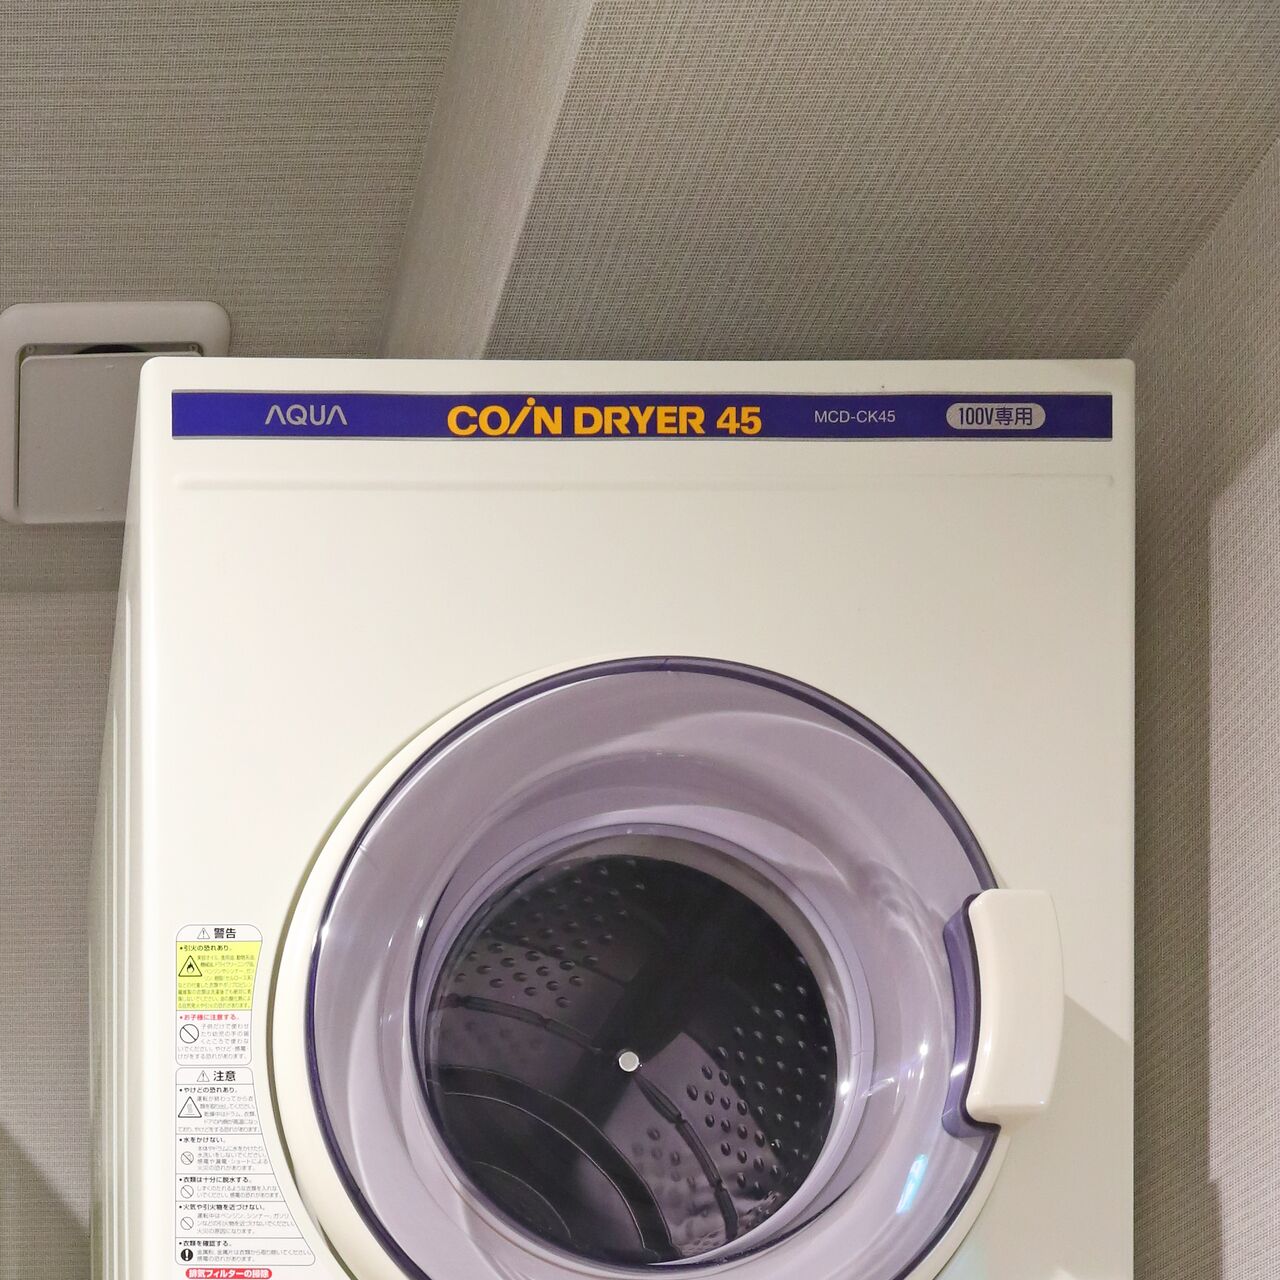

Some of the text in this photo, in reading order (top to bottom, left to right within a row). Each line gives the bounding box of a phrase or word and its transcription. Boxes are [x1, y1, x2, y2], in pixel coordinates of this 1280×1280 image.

[265, 403, 348, 427] AQUA
[574, 407, 705, 435] DRYER
[716, 407, 762, 435] 45
[814, 410, 896, 424] MCD-CK45
[957, 406, 1034, 427] 100V専用
[214, 928, 236, 939] 警告
[214, 1071, 236, 1082] 注意
